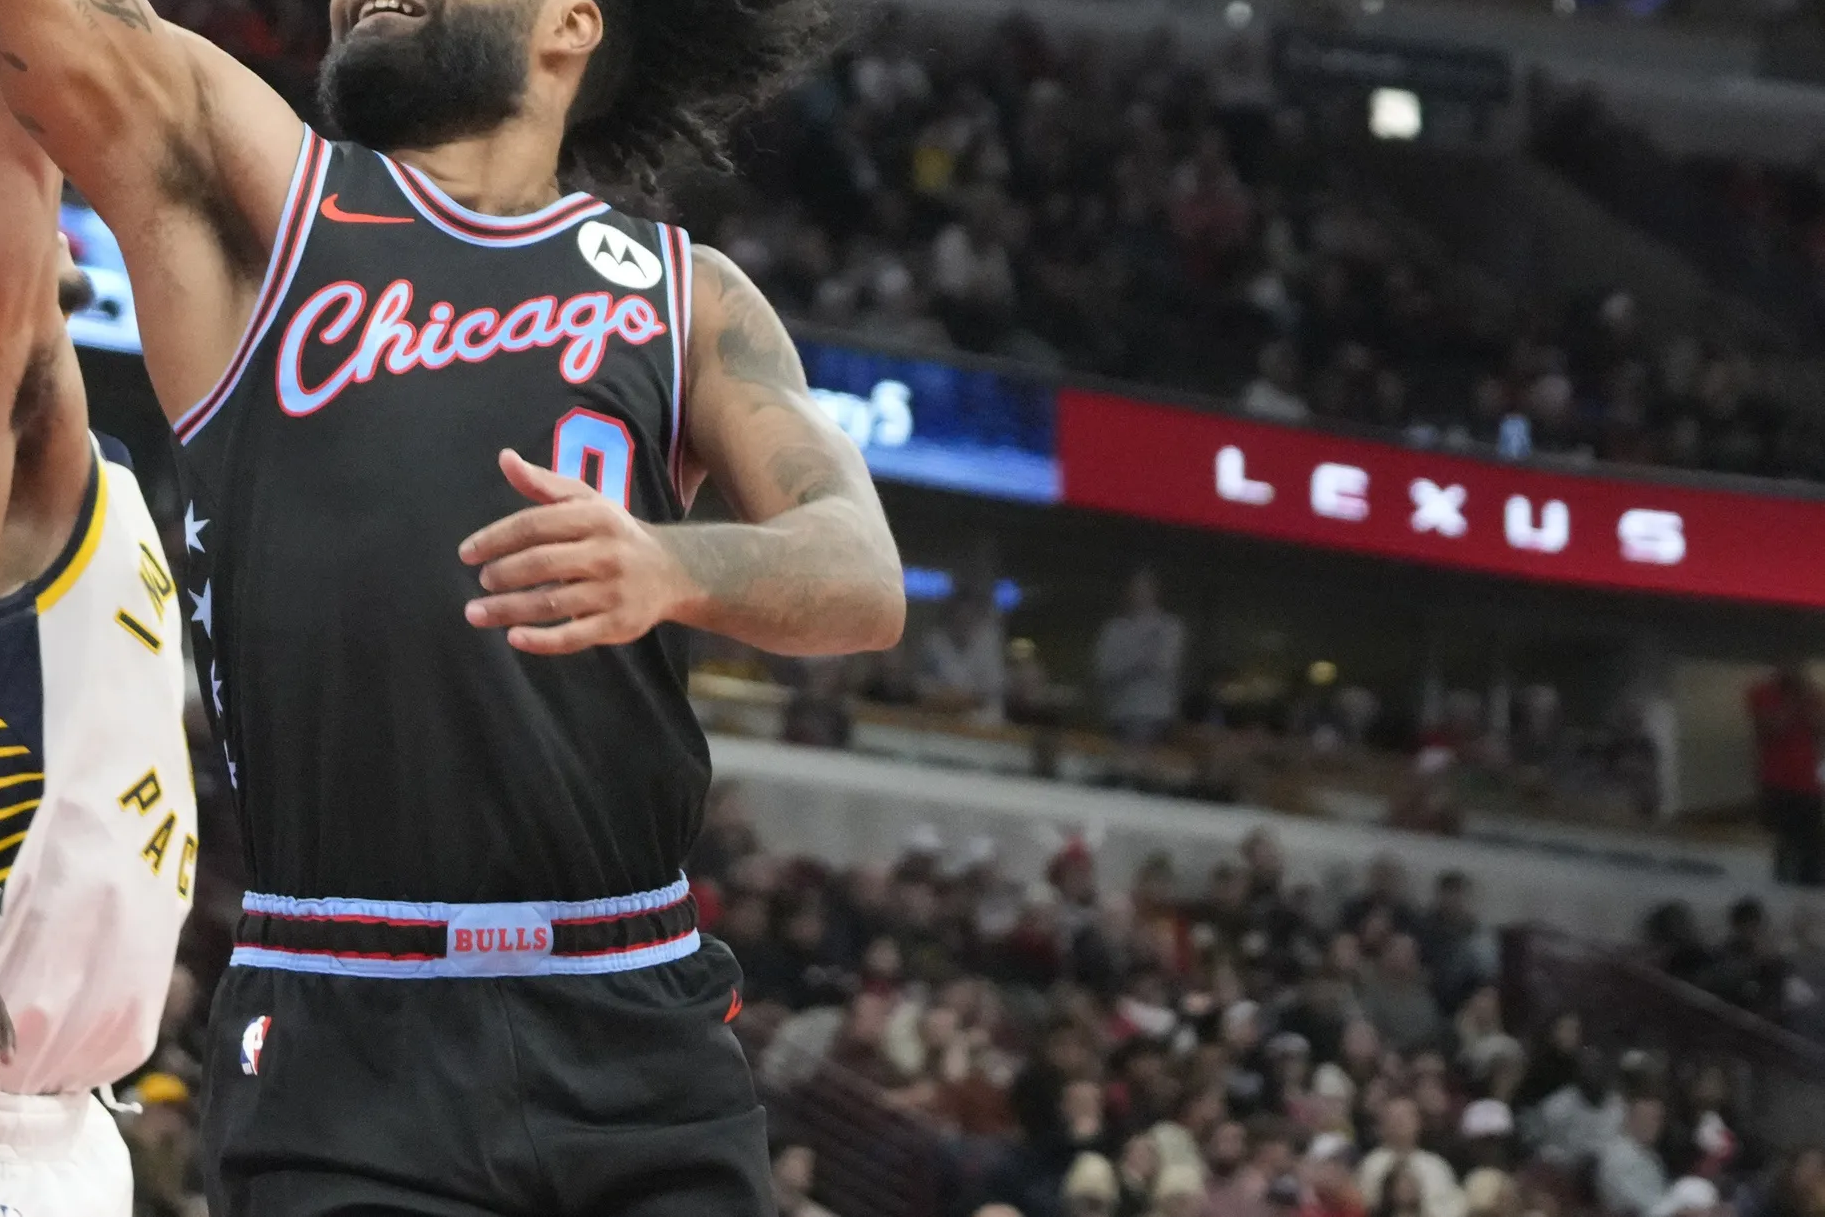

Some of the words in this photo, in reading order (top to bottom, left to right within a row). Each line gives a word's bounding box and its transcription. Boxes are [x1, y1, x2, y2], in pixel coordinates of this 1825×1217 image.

[276, 278, 666, 417] Chicago
[1213, 444, 1688, 567] LEXUS
[117, 764, 199, 901] PAC
[454, 926, 548, 953] BULLS
